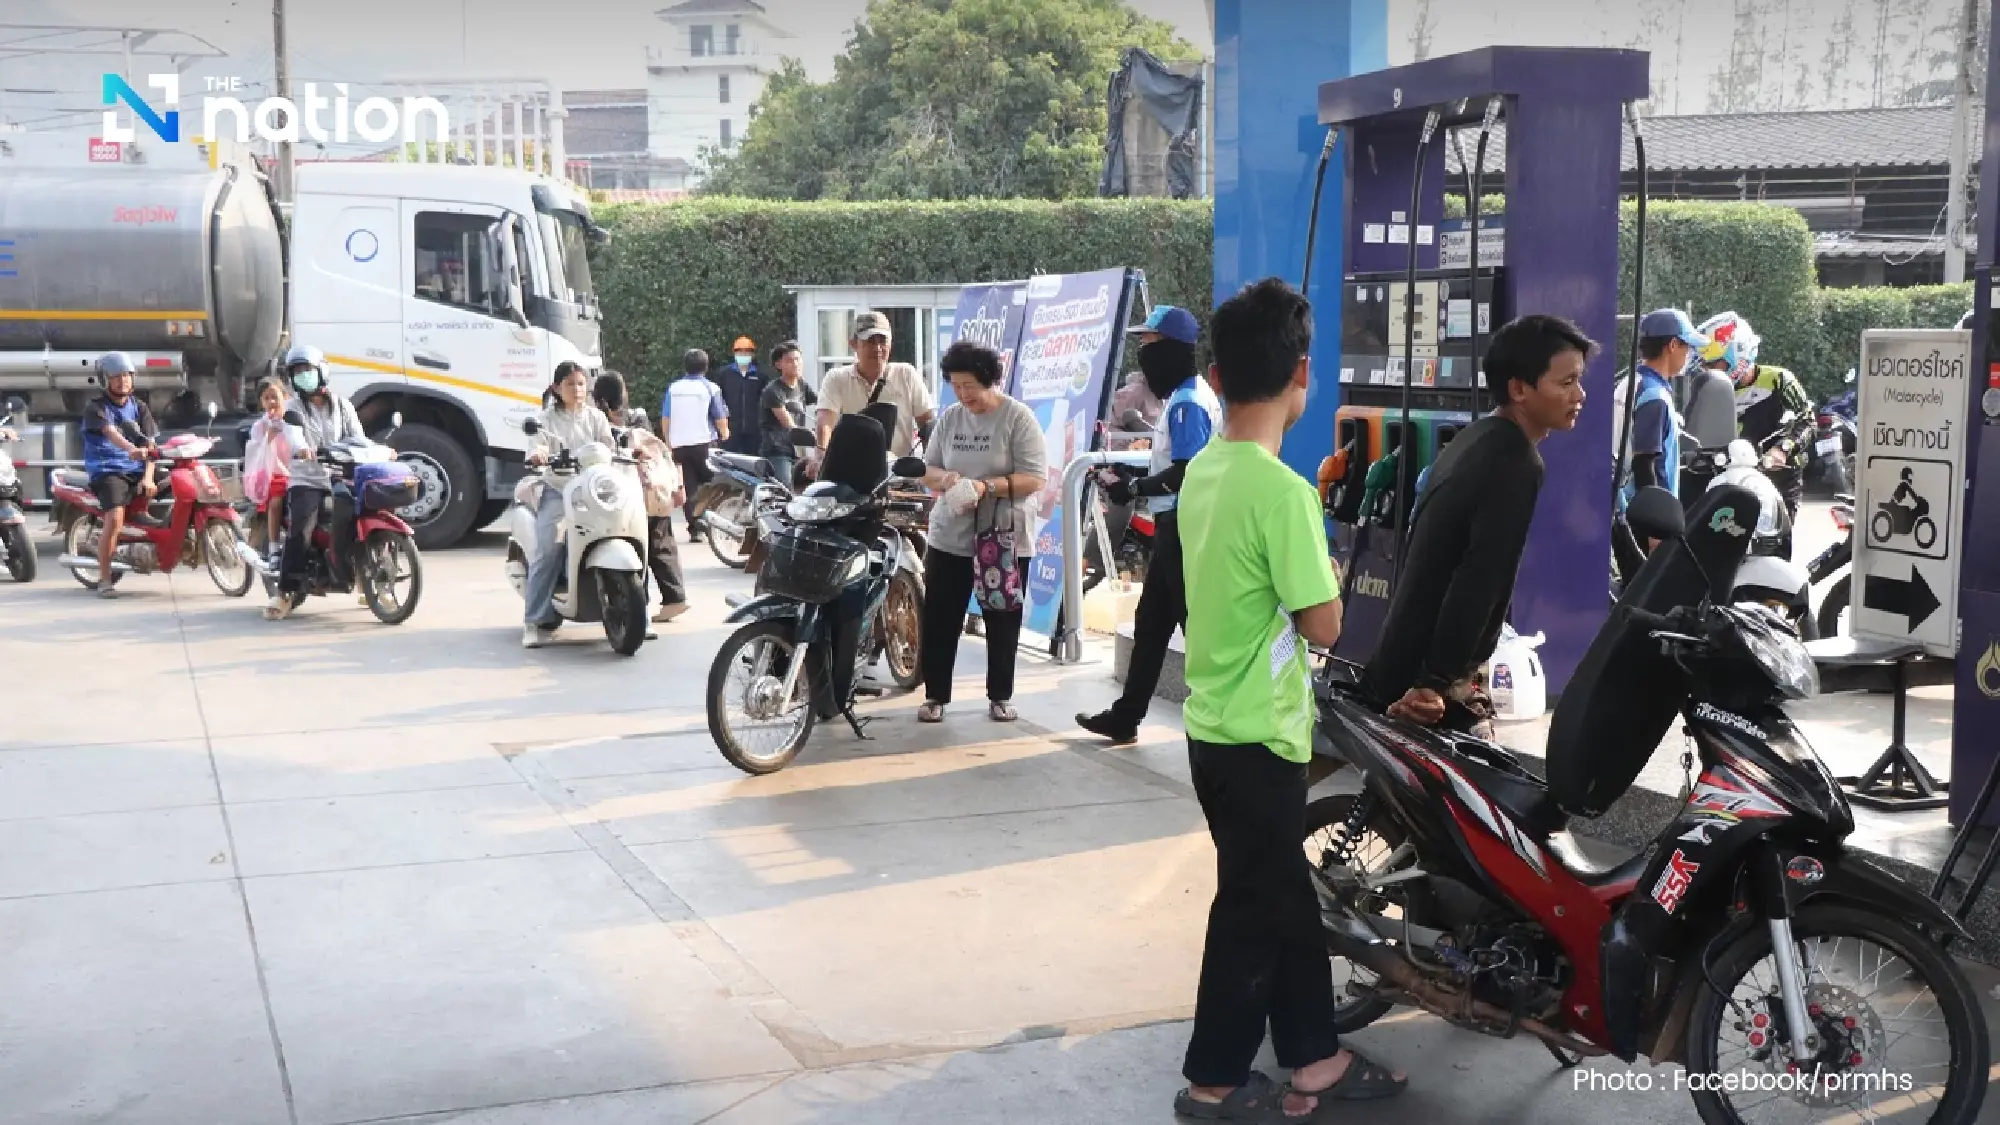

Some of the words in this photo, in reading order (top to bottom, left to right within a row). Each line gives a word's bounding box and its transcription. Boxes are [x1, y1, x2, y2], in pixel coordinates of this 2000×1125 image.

[1393, 87, 1403, 109] 9
[1884, 386, 1944, 408] (Motorcycle)
[1873, 419, 1953, 450] เชิญทางนี้
